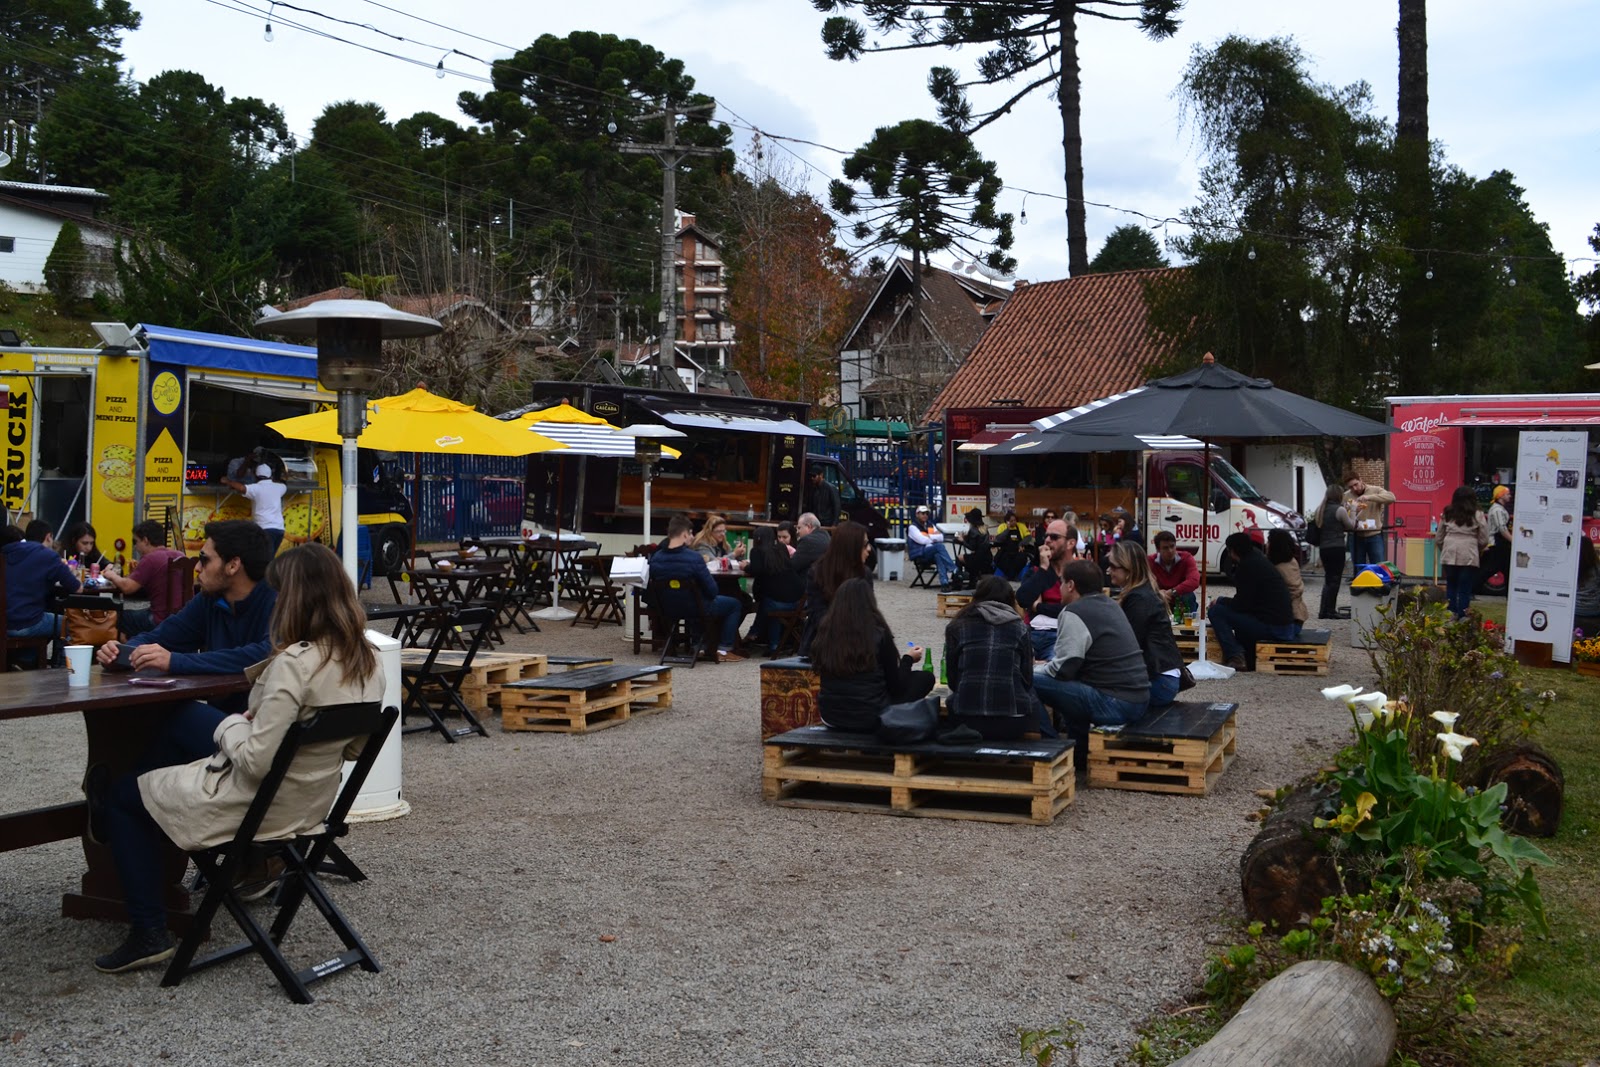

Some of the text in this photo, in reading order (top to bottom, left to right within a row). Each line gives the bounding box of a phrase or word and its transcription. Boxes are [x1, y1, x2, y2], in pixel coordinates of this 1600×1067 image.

[115, 415, 136, 423] PIZZA
[186, 469, 207, 480] CAIXA
[1413, 469, 1435, 479] GOOD
